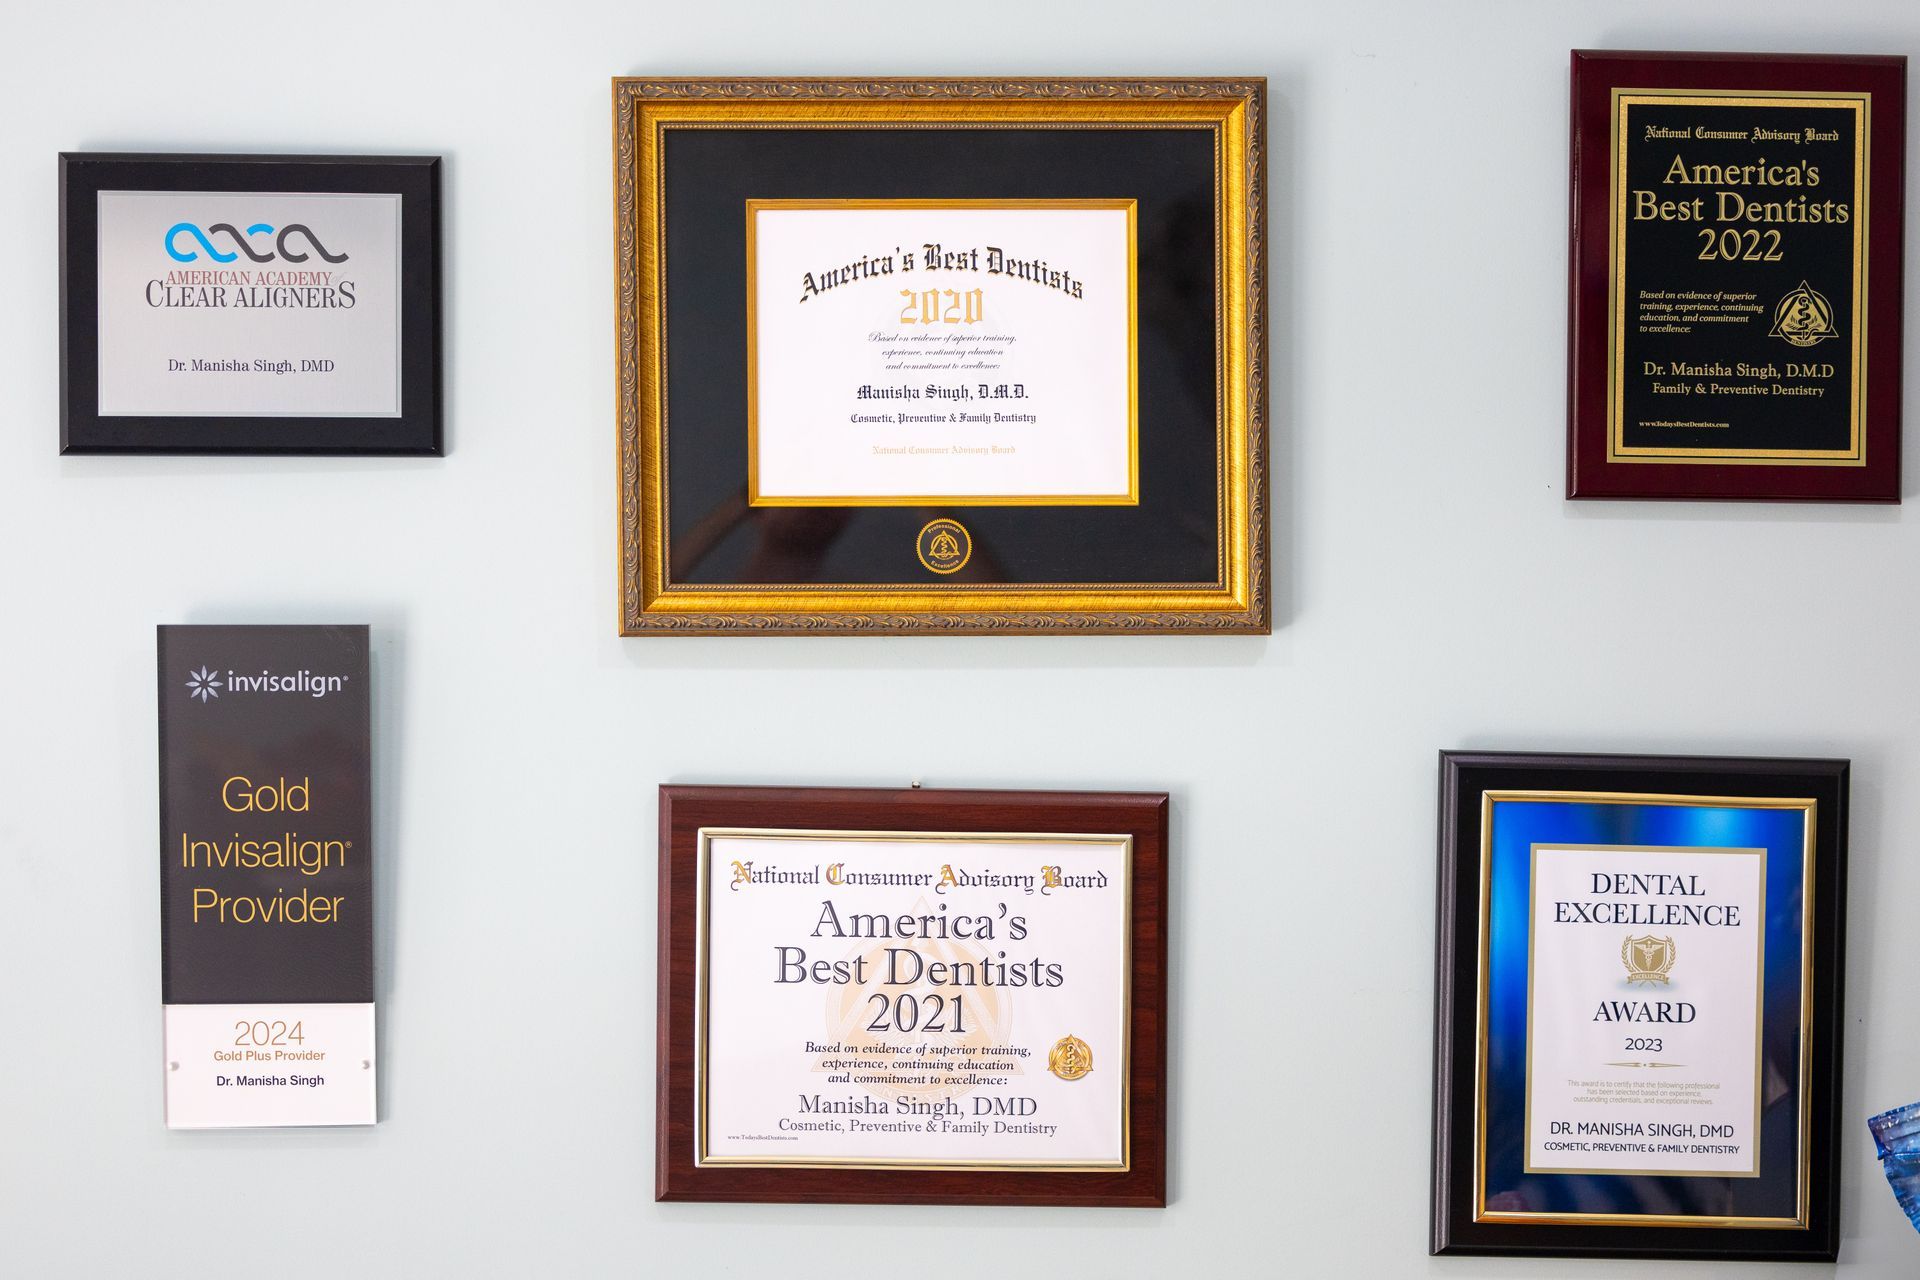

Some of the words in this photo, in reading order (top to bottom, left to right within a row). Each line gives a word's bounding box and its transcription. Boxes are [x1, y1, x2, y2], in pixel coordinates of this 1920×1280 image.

[1644, 126, 1691, 142] National
[1696, 127, 1748, 140] Consumer
[1751, 127, 1800, 144] Advisory
[1805, 128, 1839, 144] Board
[1663, 154, 1820, 186] America's
[1633, 191, 1704, 221] Best
[1716, 192, 1849, 224] Dentists
[1698, 229, 1784, 261] 2022
[166, 271, 251, 285] AMERICAN
[255, 272, 332, 286] ACADEMY
[800, 246, 915, 304] America's
[923, 243, 980, 271] Best
[986, 246, 1083, 300] Dentists
[146, 279, 228, 308] CLEAR
[234, 281, 356, 309] ALIGNERS
[1640, 290, 1664, 299] Based
[1677, 291, 1711, 299] evidence
[1713, 291, 1723, 301] of
[1723, 292, 1757, 302] superior
[900, 288, 984, 325] 2020
[1721, 304, 1764, 313] continuing
[1682, 314, 1698, 322] and
[868, 331, 898, 342] Based
[911, 334, 941, 342] evidence
[943, 334, 952, 344] of
[952, 335, 981, 344] superior
[982, 335, 1016, 344] training,
[882, 349, 922, 358] experience,
[925, 349, 965, 358] continuing
[168, 359, 186, 372] Dr.
[192, 360, 249, 372] Manisha
[254, 360, 296, 375] Singh,
[300, 360, 334, 373] DMD
[960, 361, 1000, 369] excellence:
[1644, 362, 1665, 375] Dr.
[1671, 363, 1732, 376] Manisha
[1736, 363, 1781, 379] Singh,
[1786, 364, 1834, 378] D.M.D
[857, 384, 920, 402] Manisha
[925, 384, 974, 402] Singh,
[978, 384, 1029, 399] D.M.D.
[1652, 383, 1691, 395] Family
[1695, 384, 1706, 394] &
[1711, 384, 1768, 395] Preventive
[1772, 385, 1825, 397] Dentistry
[850, 413, 895, 423] Cosmetic,
[898, 413, 946, 424] Preventive
[949, 414, 956, 422] &
[958, 413, 991, 424] Family
[993, 413, 1036, 424] Dentistry
[872, 446, 906, 455] National
[909, 446, 949, 454] Consumer
[952, 446, 989, 455] Advisory
[991, 445, 1016, 454] Board
[928, 524, 960, 534] Professional
[222, 776, 309, 812] Gold
[730, 860, 820, 891] National
[826, 862, 933, 887] Consumer
[935, 864, 1034, 895] Advisory
[1041, 866, 1108, 896] Board
[1591, 873, 1705, 896] DENTAL
[194, 888, 344, 923] Provider
[810, 900, 1028, 940] America's
[1554, 902, 1741, 927] EXCELLENCE
[774, 946, 869, 985] Best
[883, 948, 1064, 988] Dentists
[867, 994, 966, 1033] 2021
[1593, 1001, 1696, 1023] AWARD
[235, 1021, 305, 1046] 2024
[805, 1042, 841, 1054] Based
[845, 1045, 859, 1054] on
[862, 1043, 913, 1055] evidence
[917, 1042, 929, 1058] of
[930, 1044, 978, 1059] superior
[981, 1044, 1031, 1059] training,
[1625, 1038, 1662, 1052] 2023
[214, 1051, 242, 1061] Gold
[246, 1051, 271, 1061] Plus
[275, 1050, 325, 1061] Provider
[822, 1060, 888, 1073] experience,
[892, 1060, 954, 1073] continuing
[958, 1059, 1014, 1071] education
[217, 1076, 233, 1086] Dr.
[237, 1076, 286, 1086] Manisha
[290, 1075, 324, 1087] Singh
[828, 1073, 850, 1084] and
[854, 1074, 927, 1085] commitment
[930, 1075, 941, 1085] to
[944, 1073, 1008, 1087] excellence:
[1614, 1081, 1632, 1089] certify
[1657, 1082, 1684, 1090] following
[1685, 1082, 1720, 1090] professional
[798, 1095, 889, 1116] Manisha
[896, 1097, 965, 1121] Singh,
[973, 1099, 1038, 1117] DMD
[1574, 1096, 1608, 1104] outstanding
[779, 1119, 845, 1135] Cosmetic,
[850, 1120, 921, 1133] Preventive
[926, 1121, 938, 1133] &
[942, 1121, 990, 1136] Family
[994, 1122, 1057, 1137] Dentistry
[1550, 1122, 1573, 1135] DR.
[1578, 1123, 1644, 1136] MANISHA
[1648, 1124, 1695, 1138] SINGH,
[1700, 1125, 1734, 1138] DMD
[1544, 1142, 1590, 1152] COSMETIC,
[1593, 1143, 1646, 1152] PREVENTIVE
[1648, 1144, 1655, 1153] &
[1658, 1144, 1689, 1153] FAMILY
[1691, 1145, 1740, 1154] DENTISTRY
